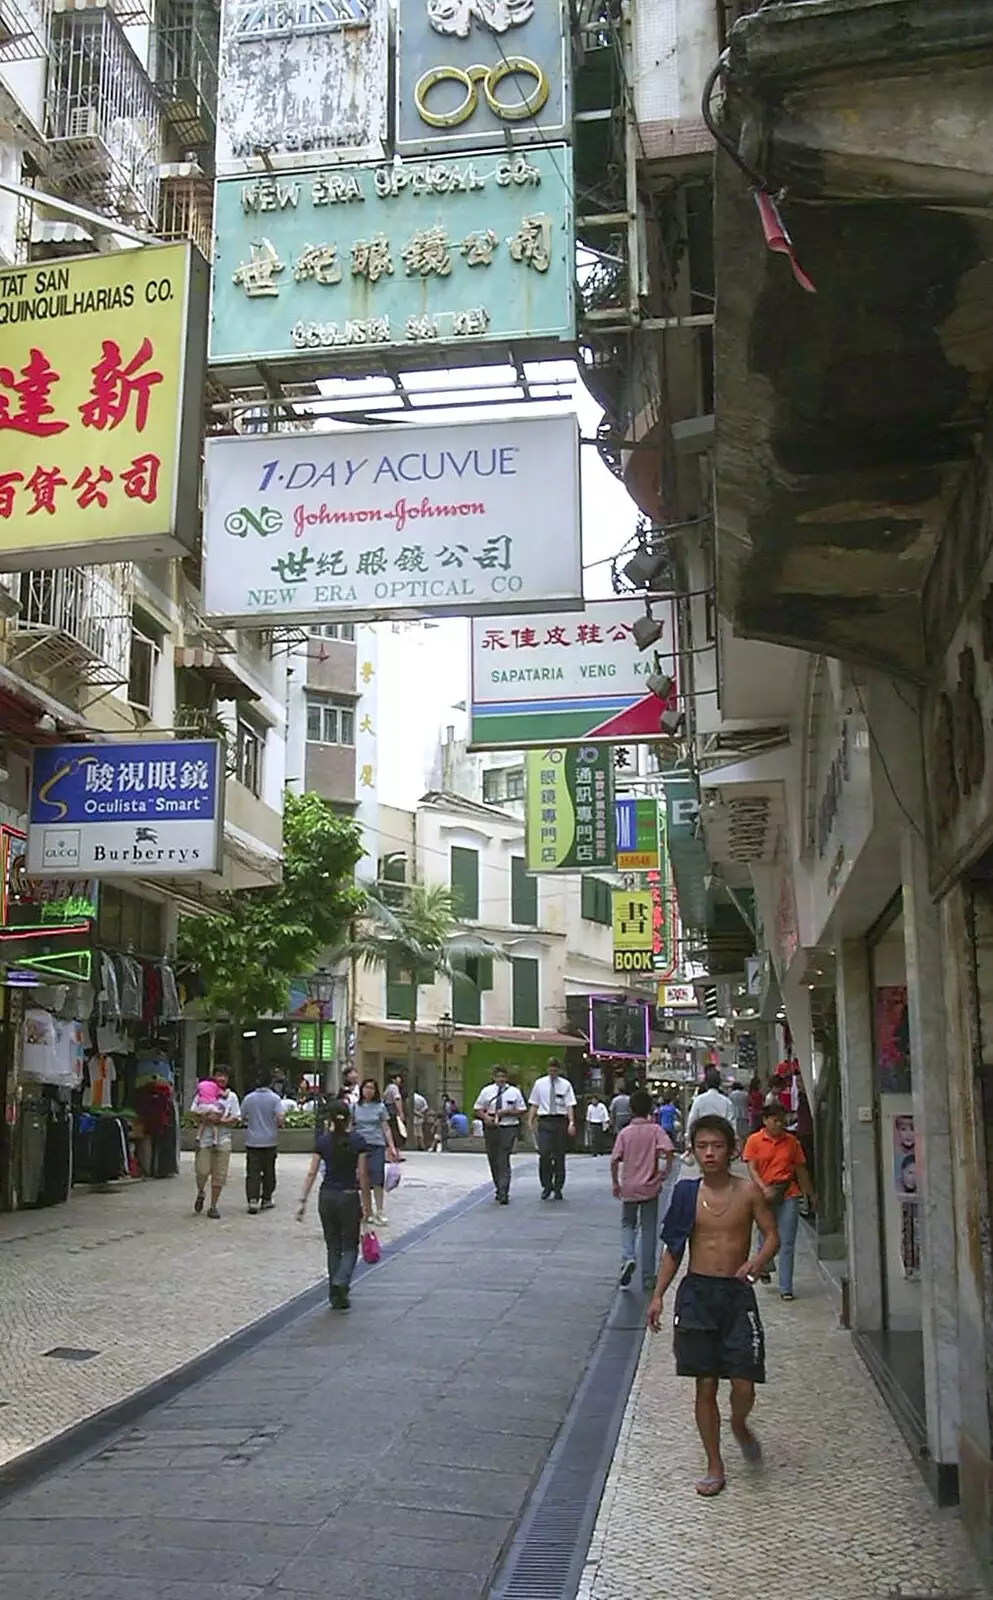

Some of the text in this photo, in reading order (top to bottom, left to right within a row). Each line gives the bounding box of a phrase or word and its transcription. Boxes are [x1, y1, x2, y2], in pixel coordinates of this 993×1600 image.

[241, 177, 301, 214] NEW
[312, 172, 365, 207] ERA
[375, 160, 485, 199] OPTICAL
[232, 212, 553, 298] 世紀眼鏡公司
[0, 267, 70, 298] TAT SAN
[0, 278, 175, 325] QUINQUILHARIAS CO.
[373, 447, 520, 485] ACUVUE
[0, 453, 161, 520] 百貨公司
[247, 574, 523, 608] NEW ERA OPTICAL CO
[481, 620, 664, 652] 永佳皮鞋公
[490, 666, 565, 684] SAPATARIA
[579, 663, 617, 679] VENG
[84, 759, 210, 793] 駿視眼鏡
[84, 798, 147, 815] Oculista
[45, 848, 78, 859] GUCCI
[93, 845, 201, 864] Burberrys
[615, 952, 652, 970] BOOK
